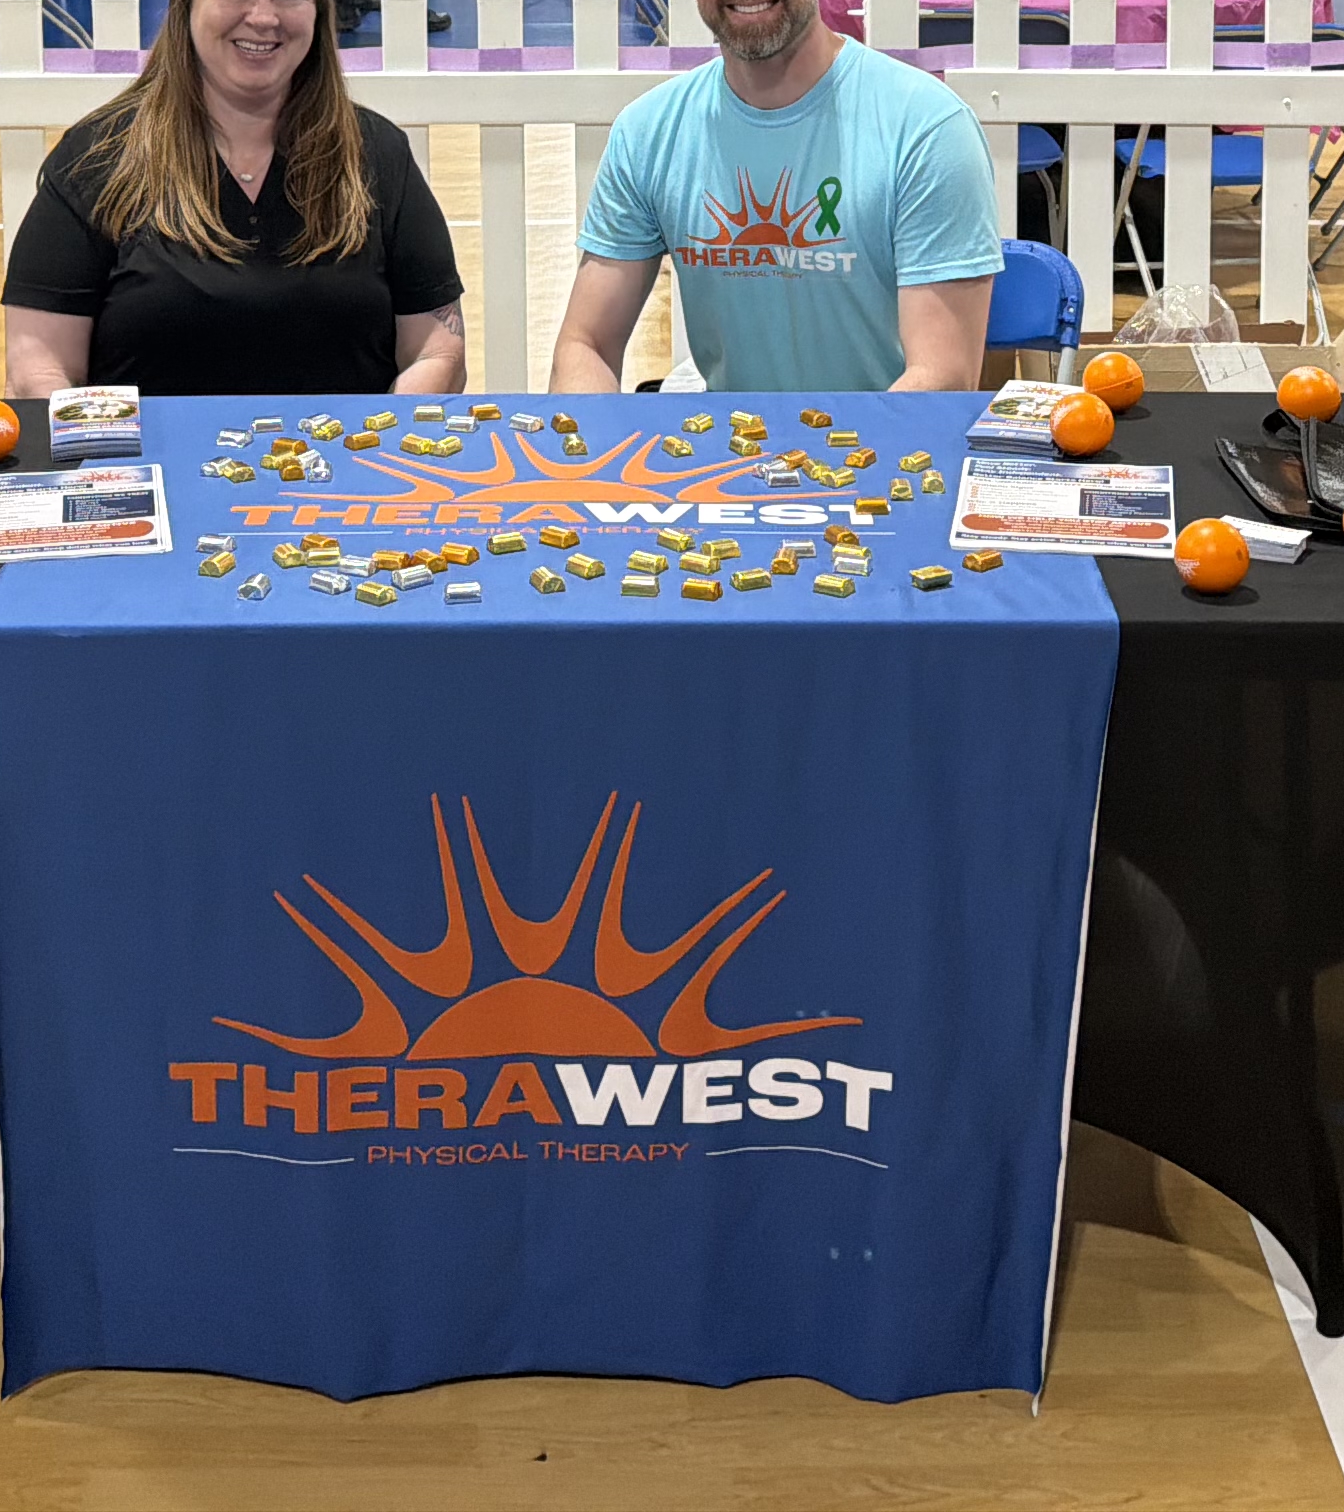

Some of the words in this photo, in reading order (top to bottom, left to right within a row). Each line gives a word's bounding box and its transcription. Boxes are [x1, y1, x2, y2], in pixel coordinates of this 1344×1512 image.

[675, 246, 857, 272] THERAWEST
[230, 503, 891, 525] THERAWEST
[405, 527, 540, 536] PHYSICA
[169, 1058, 893, 1134] THERAWEST
[367, 1141, 529, 1165] PHYSICAL
[539, 1140, 690, 1164] THERAPY
